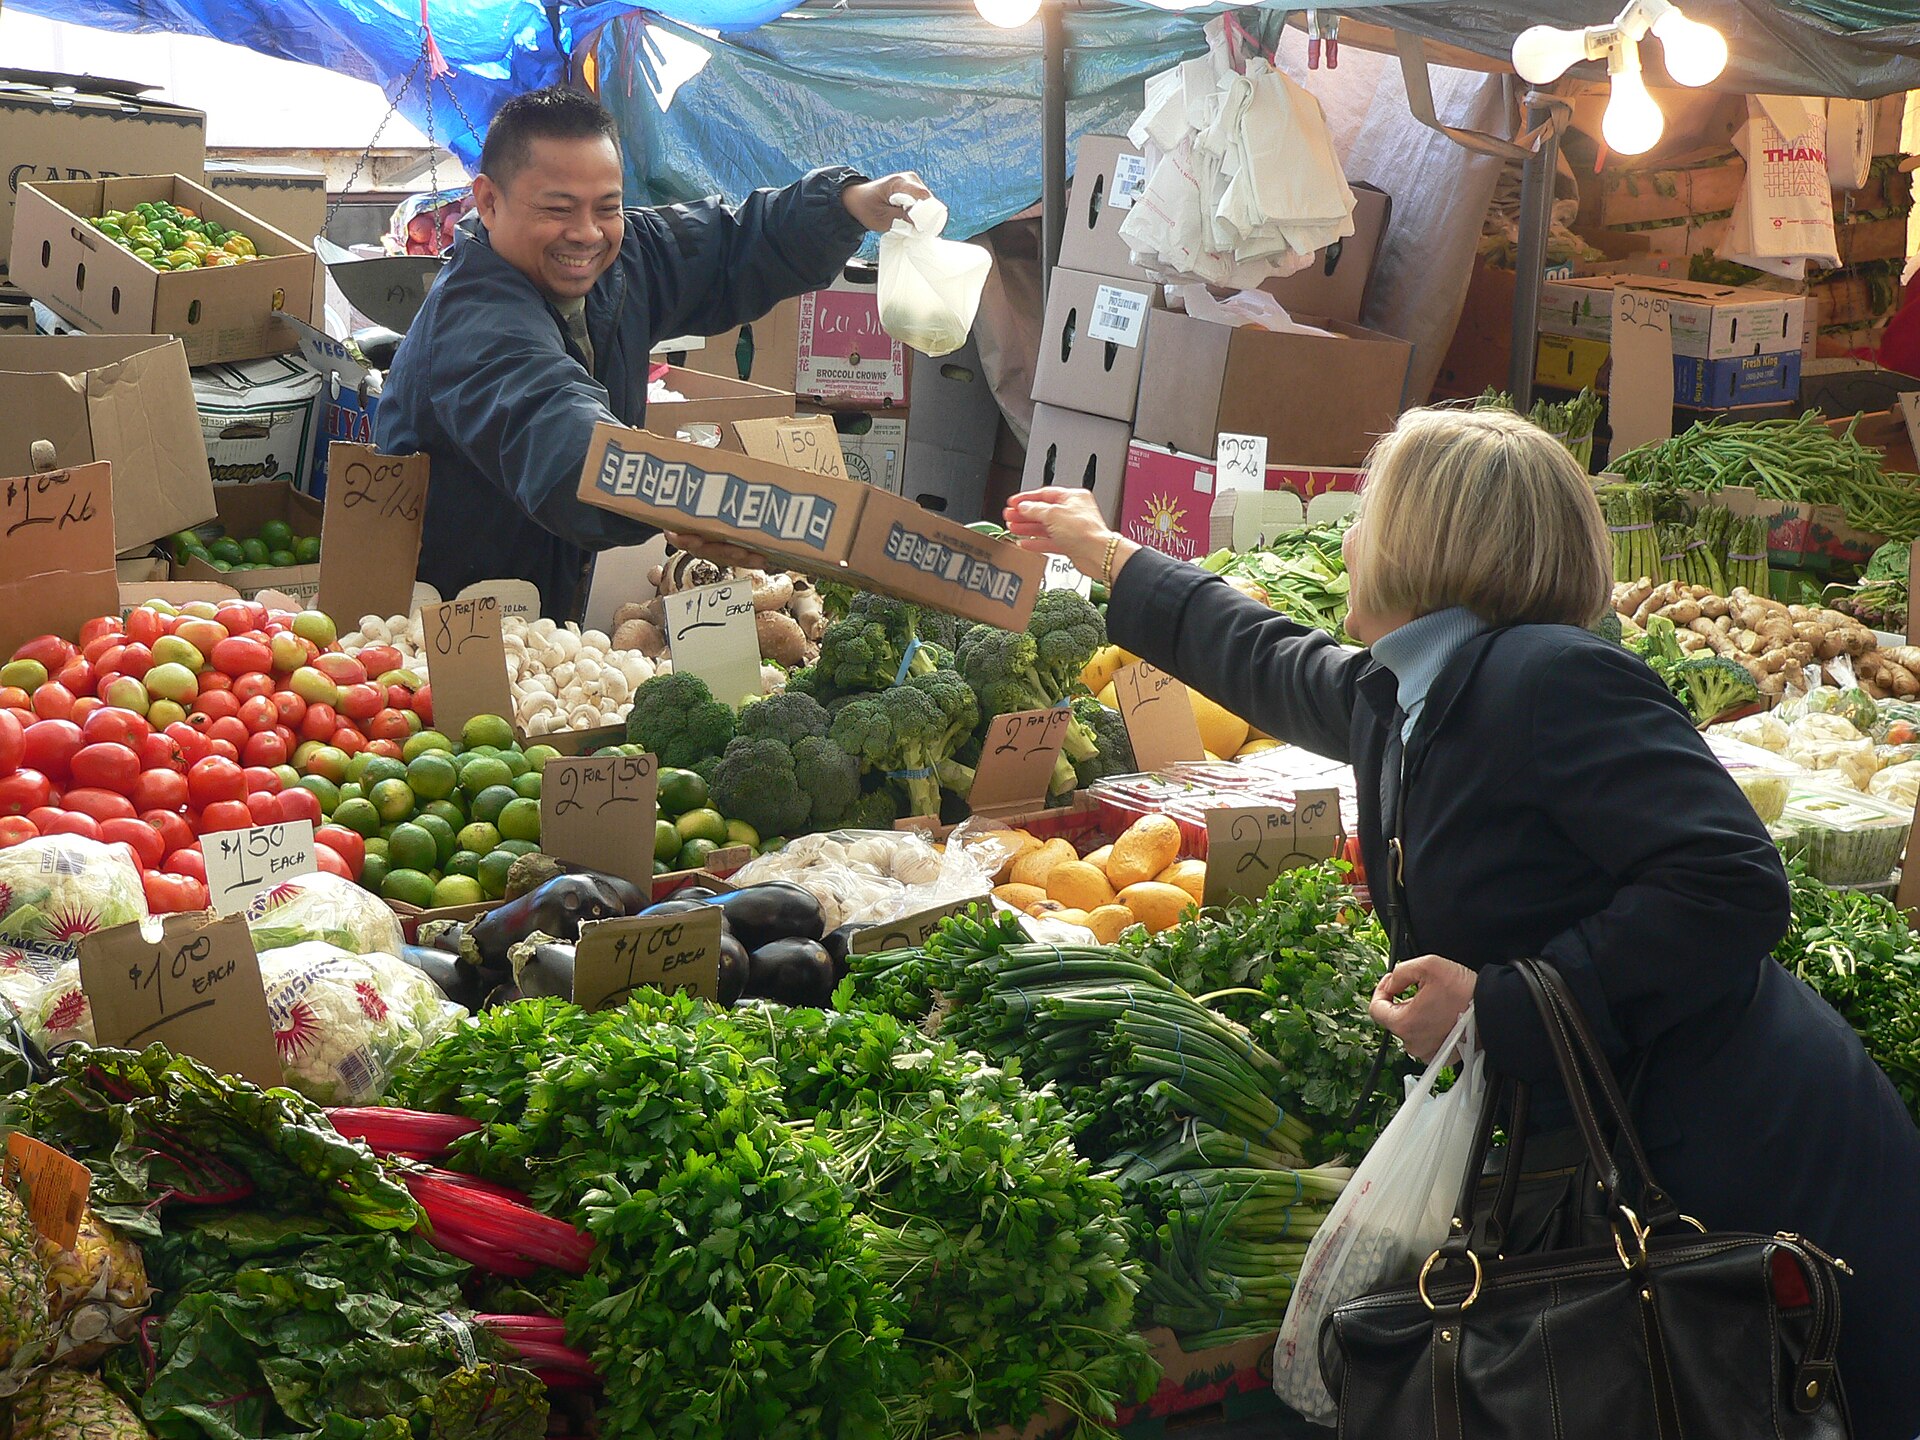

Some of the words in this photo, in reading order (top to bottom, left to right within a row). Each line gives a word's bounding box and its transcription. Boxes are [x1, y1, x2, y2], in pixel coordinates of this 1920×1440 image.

[1620, 293, 1637, 324] 2
[816, 368, 854, 379] BROCCOLI
[855, 370, 887, 380] CROWNS
[1742, 358, 1761, 370] Fresh
[1762, 355, 1778, 368] King
[600, 451, 702, 507] ACRES
[722, 483, 833, 542] PINEY
[886, 529, 951, 572] ACRES
[960, 560, 1020, 602] PINEY
[503, 605, 512, 613] 10
[513, 605, 528, 613] Lbs.
[725, 601, 755, 617] EACH
[435, 604, 452, 655] 8
[455, 603, 472, 616] FOR
[995, 717, 1022, 755] 2
[1026, 715, 1044, 727] FOR
[555, 767, 584, 816] 2
[582, 767, 607, 785] FOR
[1231, 814, 1269, 873] 2
[1266, 814, 1291, 830] FOR
[270, 851, 306, 874] EACH
[192, 959, 236, 994] EACH
[662, 947, 706, 973] EACH
